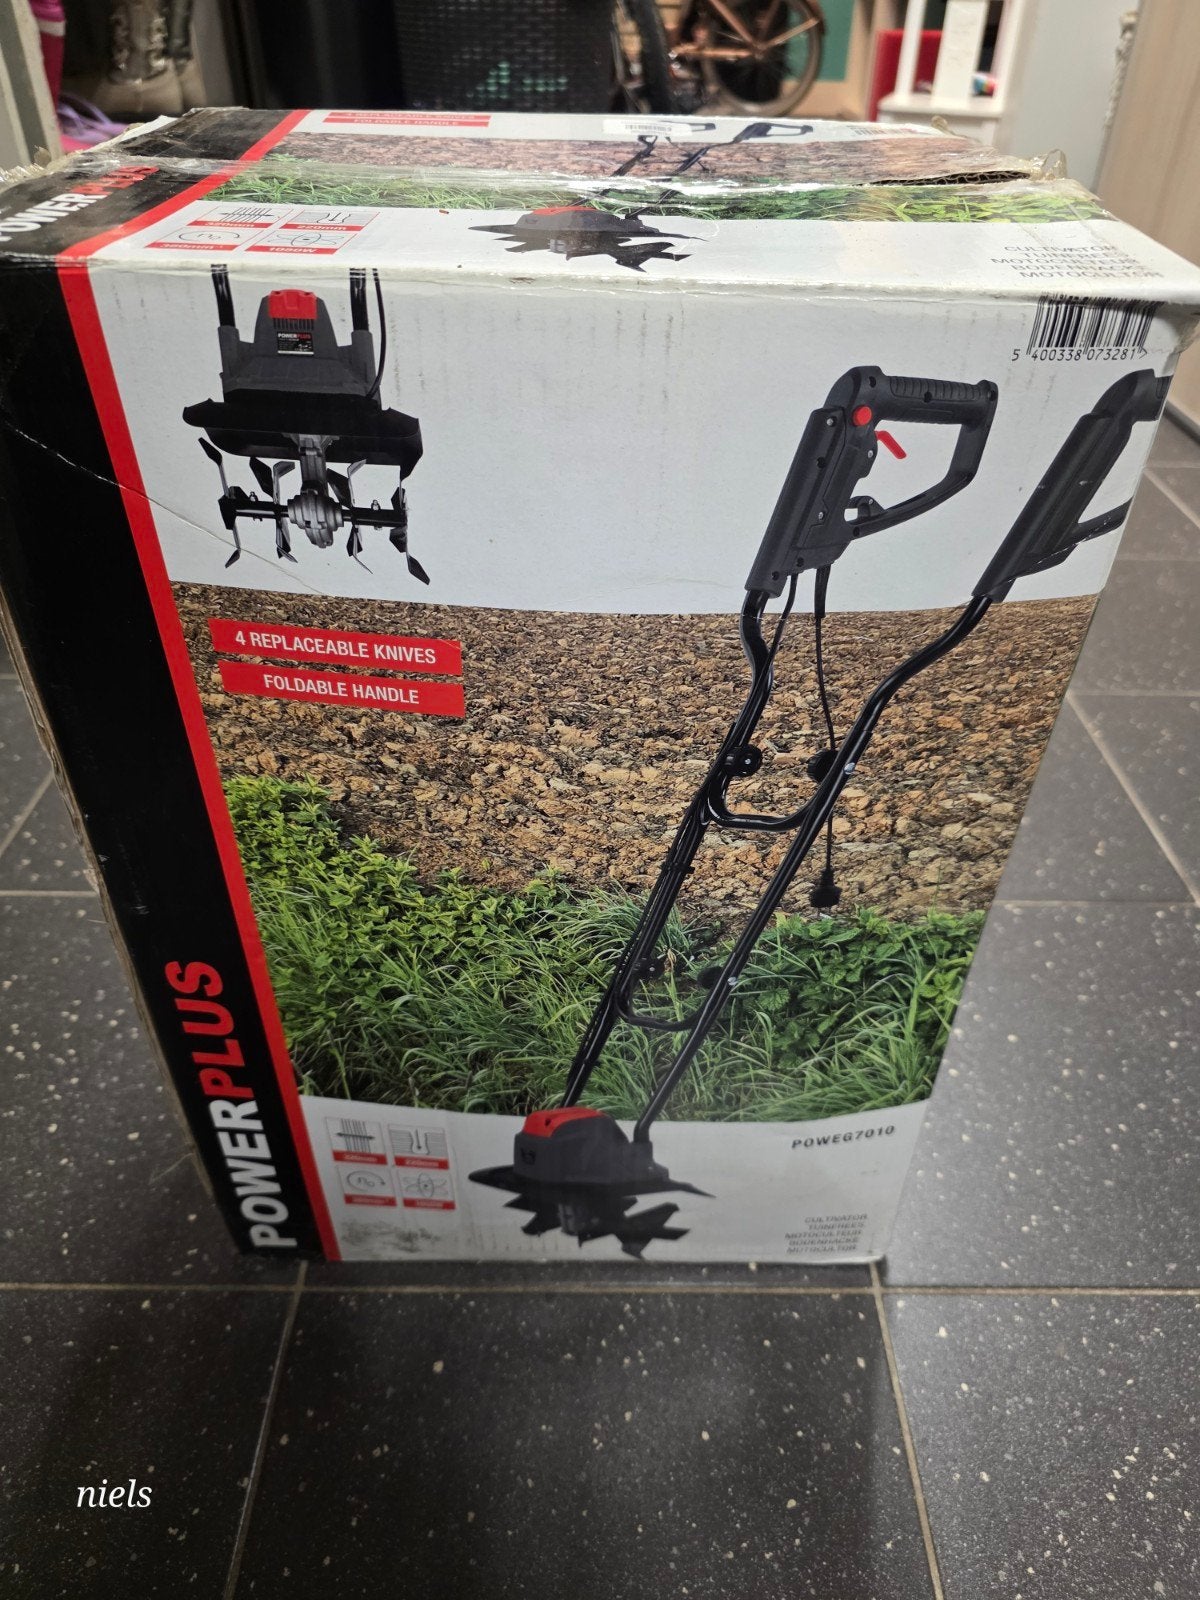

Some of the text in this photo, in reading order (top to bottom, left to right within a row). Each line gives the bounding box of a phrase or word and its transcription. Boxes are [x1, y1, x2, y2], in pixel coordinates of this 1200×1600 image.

[1004, 245, 1118, 253] CULTIVATOR
[1012, 348, 1136, 361] 5 400338 073281
[235, 630, 436, 664] 4 REPLACEABLE KNIVES
[263, 674, 420, 704] FOLDABLE HANDLE
[164, 960, 298, 1249] POWERPLUS
[791, 1125, 895, 1149] POWEG7010
[804, 1213, 868, 1223] CULTIVATOR
